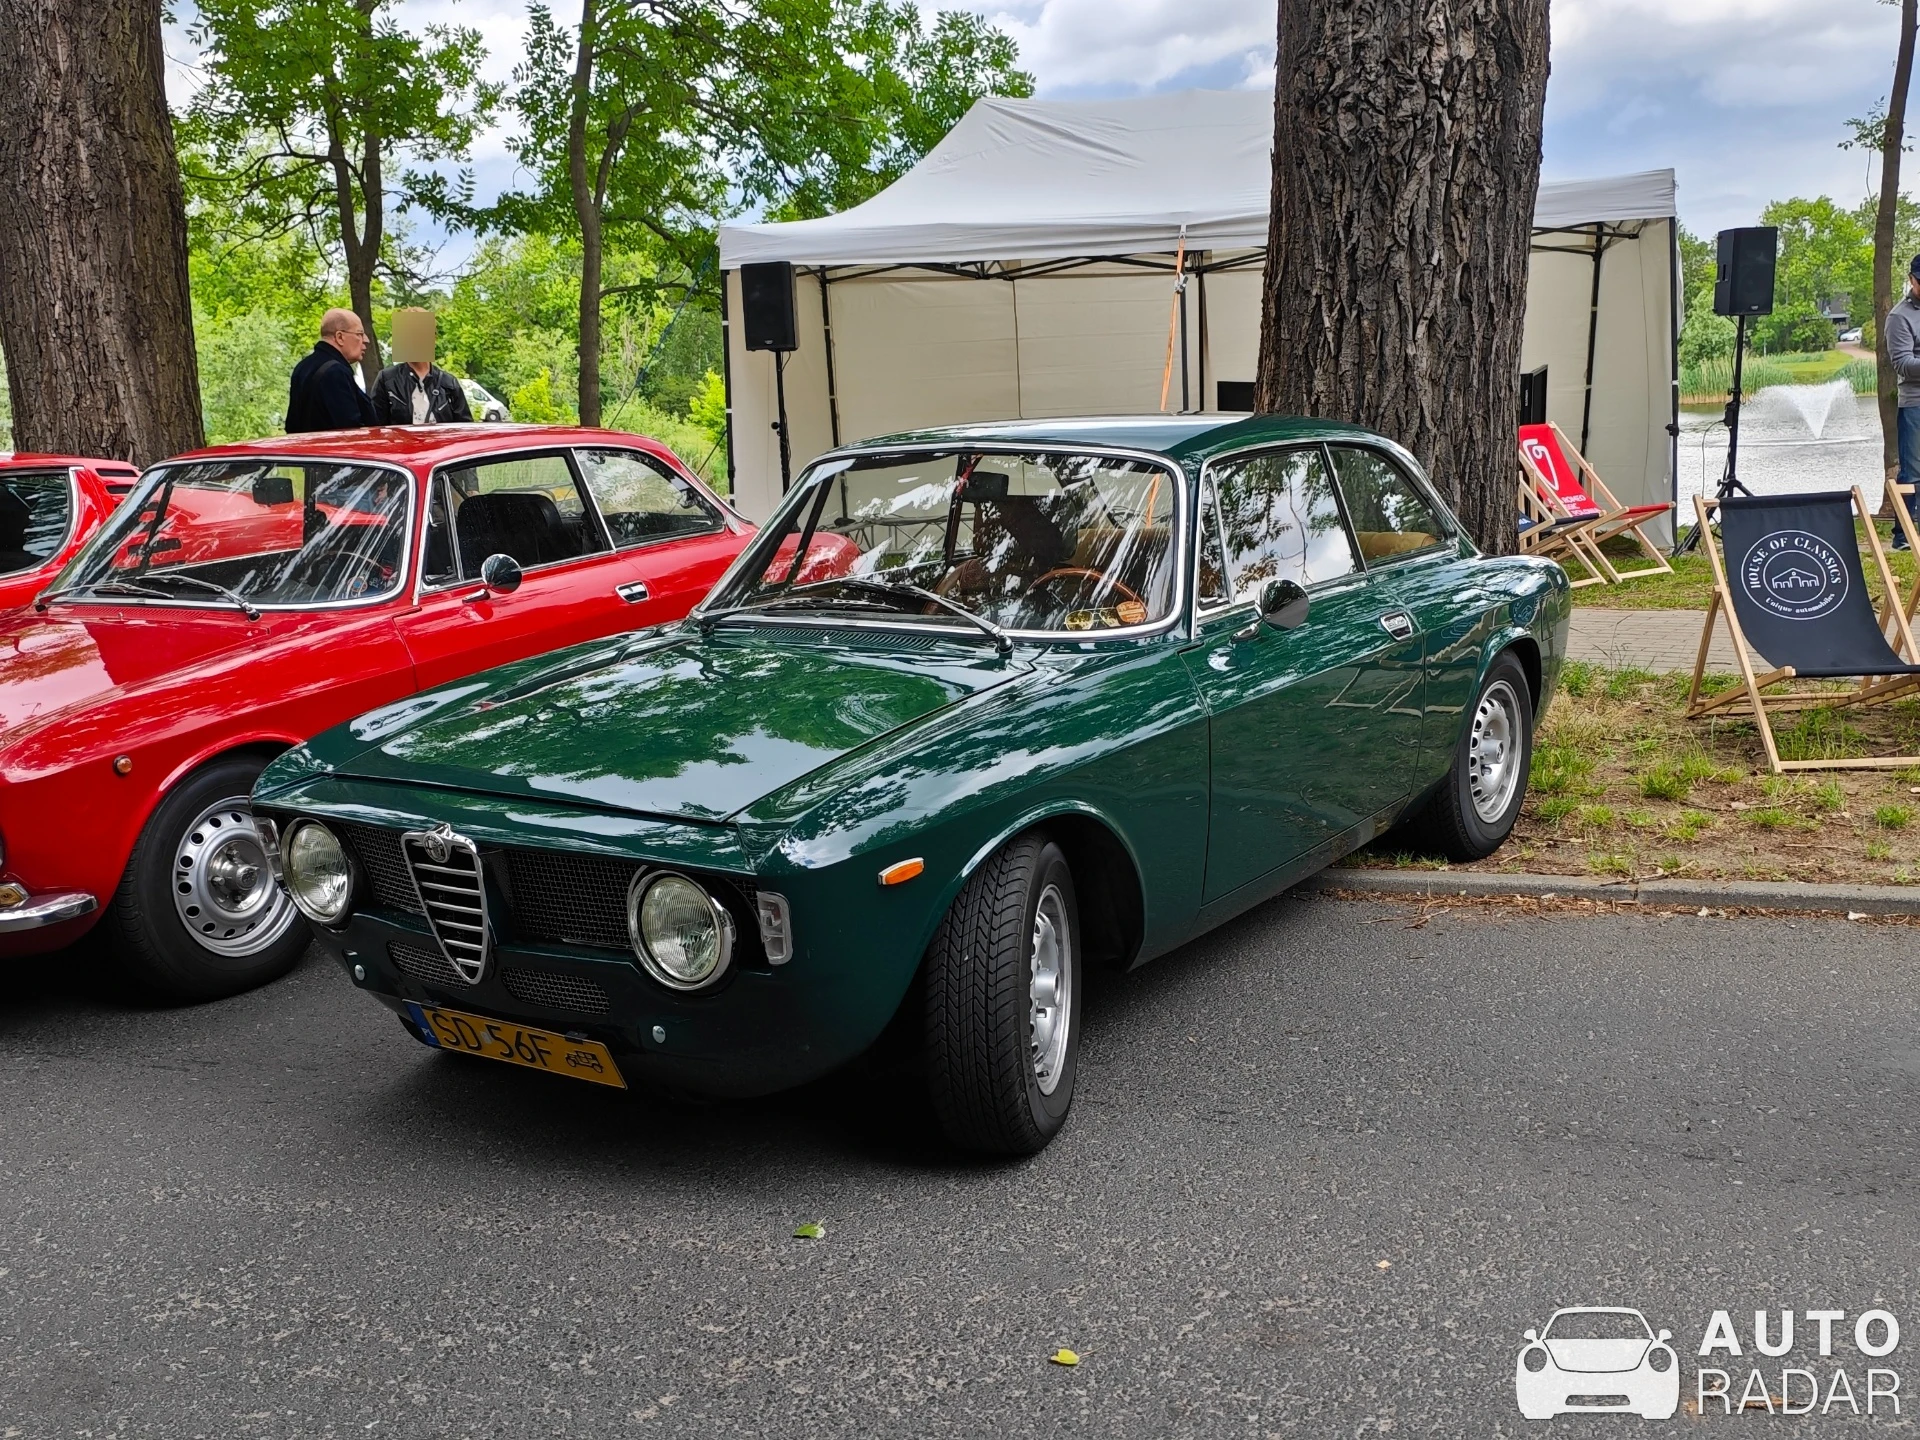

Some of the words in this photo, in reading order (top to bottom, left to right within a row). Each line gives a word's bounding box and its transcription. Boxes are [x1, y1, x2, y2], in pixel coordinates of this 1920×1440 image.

[1748, 547, 1769, 589] HOUSE
[1769, 537, 1788, 550] OF
[1794, 536, 1842, 584] CLASSICS
[1765, 596, 1793, 612] Unique
[1795, 593, 1835, 613] automobiles
[421, 1027, 435, 1039] PL
[431, 1012, 482, 1051] SD
[485, 1023, 552, 1067] 56F
